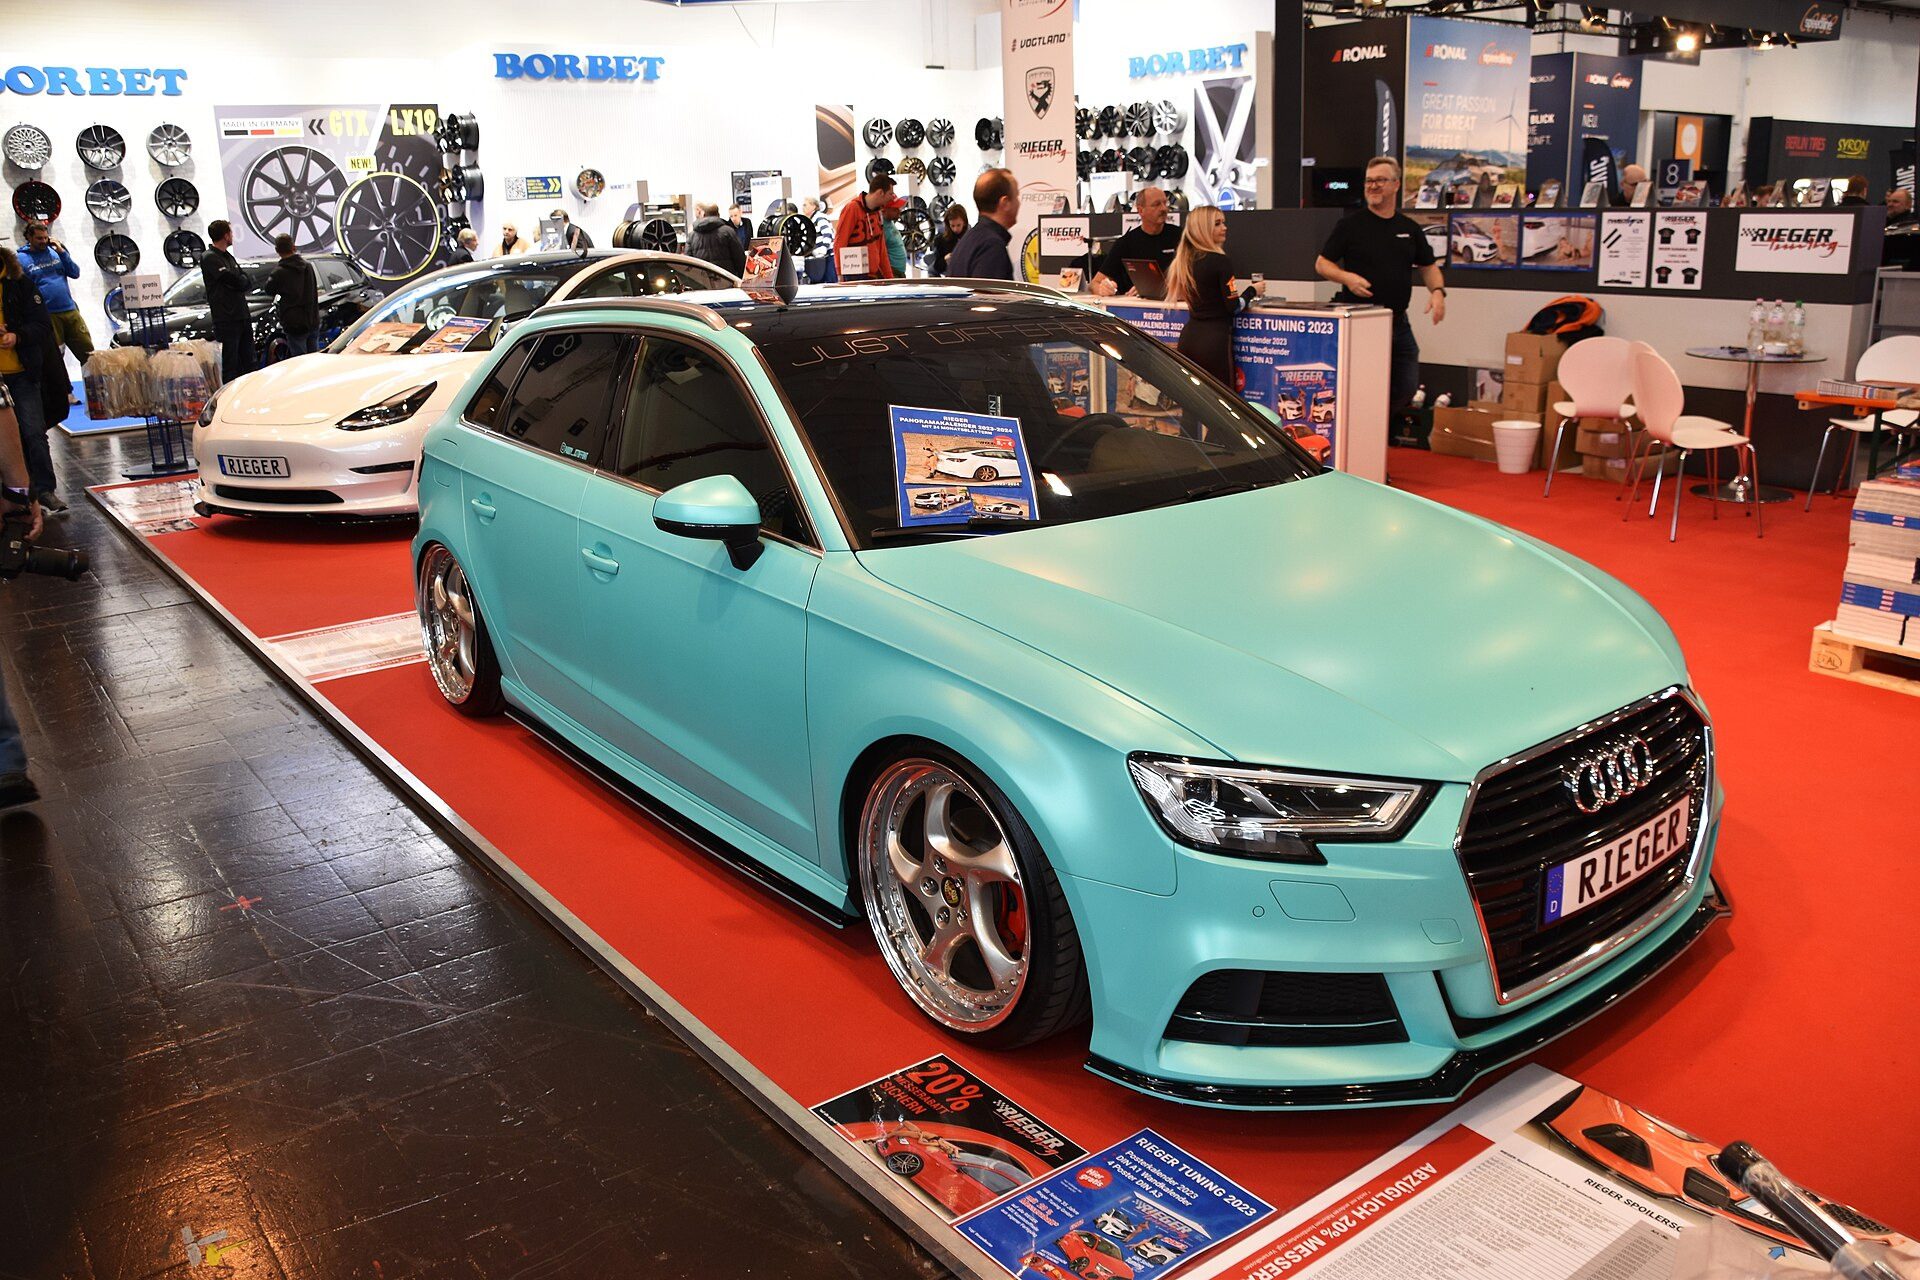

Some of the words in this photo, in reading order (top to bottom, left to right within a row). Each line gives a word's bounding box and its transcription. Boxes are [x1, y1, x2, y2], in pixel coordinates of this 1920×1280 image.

[1020, 33, 1066, 48] VOGTLAND
[1342, 45, 1387, 62] RONAL
[1433, 44, 1467, 60] RONAL
[493, 53, 665, 81] BORBET
[1128, 43, 1247, 79] BORBET
[0, 65, 188, 95] ORBET
[1422, 93, 1454, 110] GREAT
[1456, 95, 1496, 112] PASSION
[260, 120, 299, 128] GERMANY
[329, 109, 369, 137] GTX
[390, 109, 436, 136] LX19
[1422, 114, 1441, 130] FOR
[1443, 115, 1478, 131] GREAT
[1020, 140, 1063, 154] RIEGER
[1837, 139, 1870, 153] SYRON
[350, 158, 372, 169] NEW!
[1666, 163, 1679, 185] 8
[1047, 227, 1081, 237] RIEGER
[1751, 228, 1834, 243] RIEGER
[142, 281, 158, 289] gratis
[142, 294, 150, 302] for
[151, 293, 162, 301] free
[1143, 312, 1164, 320] RIEGER
[1233, 317, 1262, 330] IEGER
[1264, 318, 1305, 332] TUNING
[1308, 321, 1333, 334] 2023
[792, 333, 909, 367] JUST
[1273, 338, 1287, 346] 2023
[1250, 346, 1290, 356] Wandkalender
[1286, 371, 1323, 382] RIEGER
[900, 417, 976, 429] PANORAMAKALENDER
[941, 426, 992, 435] MONATSBLÄTTERN
[228, 458, 281, 475] RIEGER
[1550, 900, 1558, 913] D
[1578, 808, 1681, 904] RIEGER
[905, 1062, 984, 1113] 20%
[880, 1081, 927, 1115] SICHERN
[1002, 1105, 1065, 1149] RIEGER
[1079, 1174, 1104, 1188] gratis
[1086, 1168, 1105, 1180] Hier
[1112, 1164, 1141, 1182] Poster
[1135, 1180, 1151, 1192] DIN
[1149, 1189, 1163, 1199] A3
[1116, 1155, 1132, 1167] DIN
[1130, 1164, 1142, 1174] A1
[1141, 1170, 1192, 1207] Wandkalender
[1125, 1150, 1178, 1187] Posterkalender
[1177, 1184, 1198, 1200] 2023
[1135, 1137, 1180, 1167] RIEGER
[1178, 1163, 1226, 1197] TUNING
[1223, 1194, 1257, 1217] 2023
[1351, 1162, 1438, 1220] ABZÜGLICH
[1584, 1177, 1623, 1201] RIEGER
[1624, 1198, 1684, 1233] SPOILERSC
[1138, 1203, 1193, 1234] RIEGER
[1320, 1216, 1357, 1238] 20%
